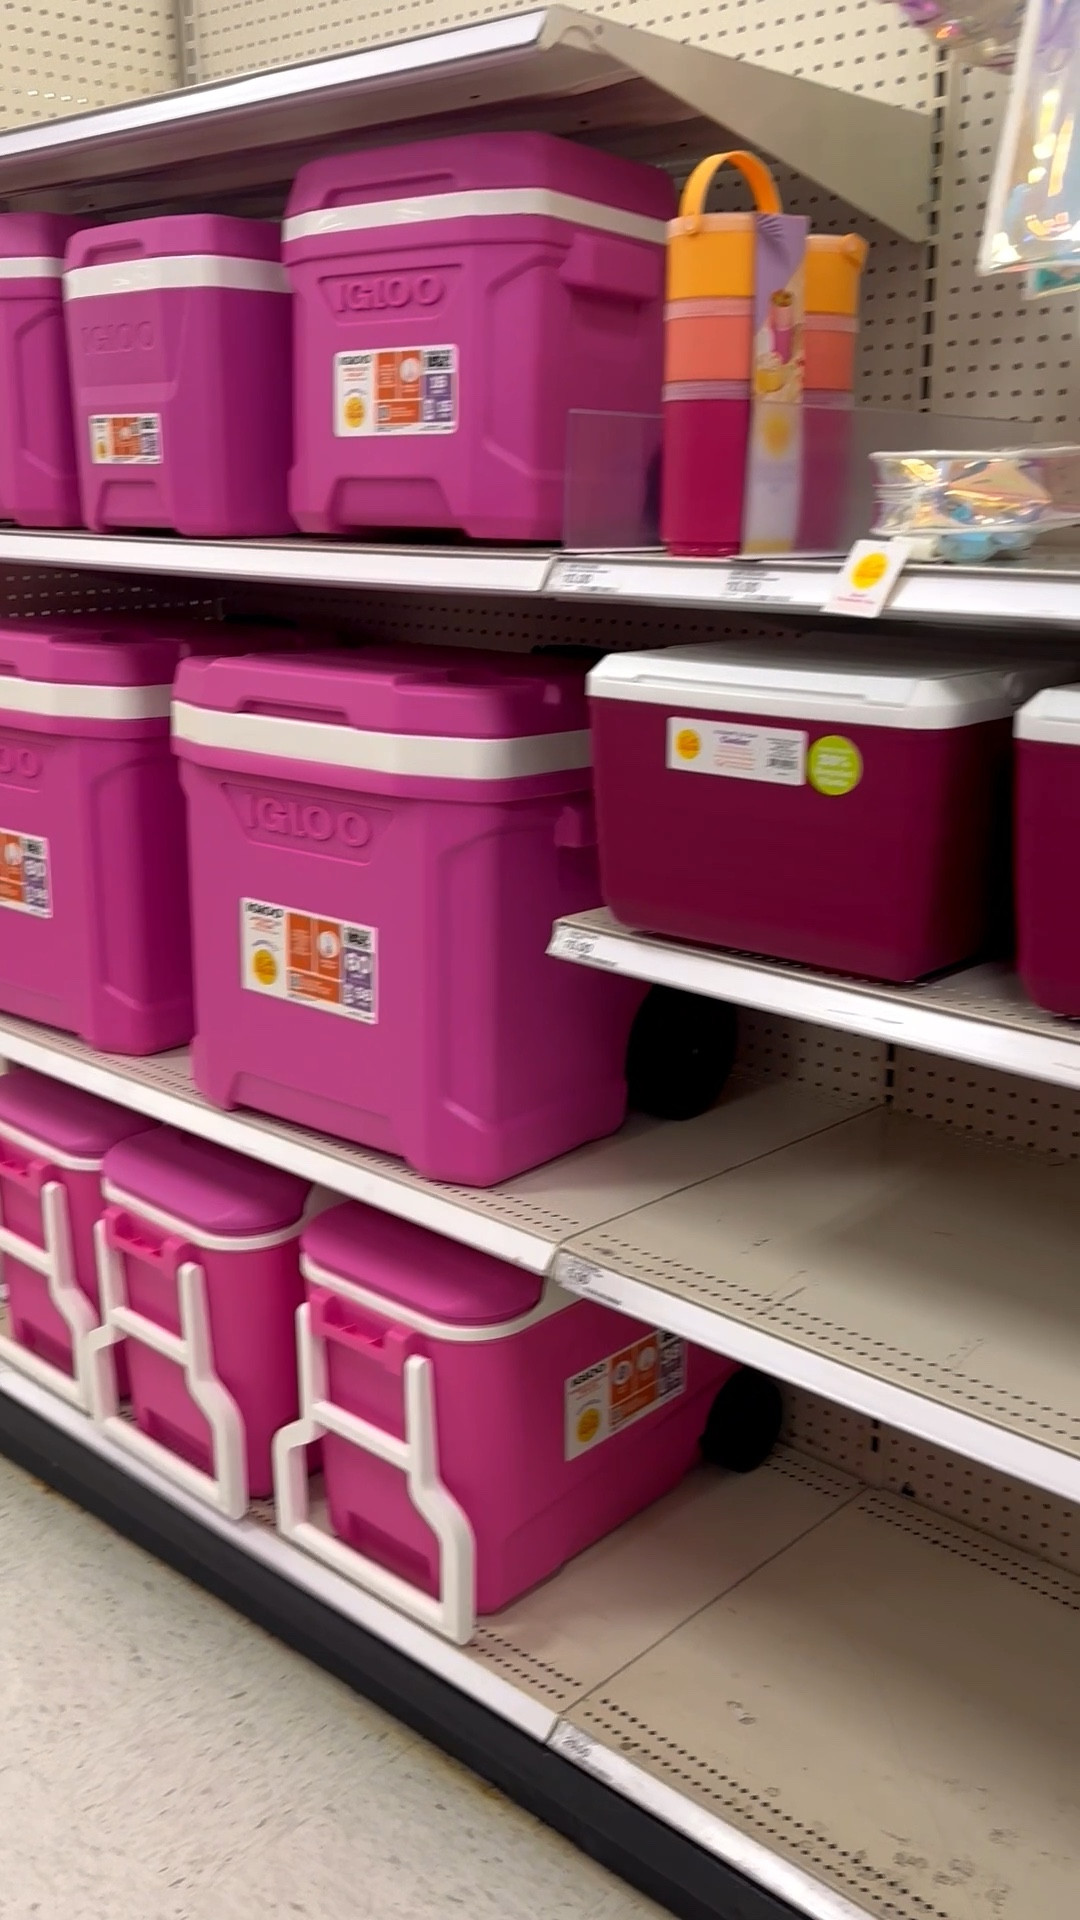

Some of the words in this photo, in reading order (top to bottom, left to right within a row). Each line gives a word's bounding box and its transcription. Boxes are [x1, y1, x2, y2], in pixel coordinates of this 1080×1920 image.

[336, 275, 446, 312] IGLOO
[81, 320, 155, 355] IGLOO
[246, 793, 373, 848] IGLOO
